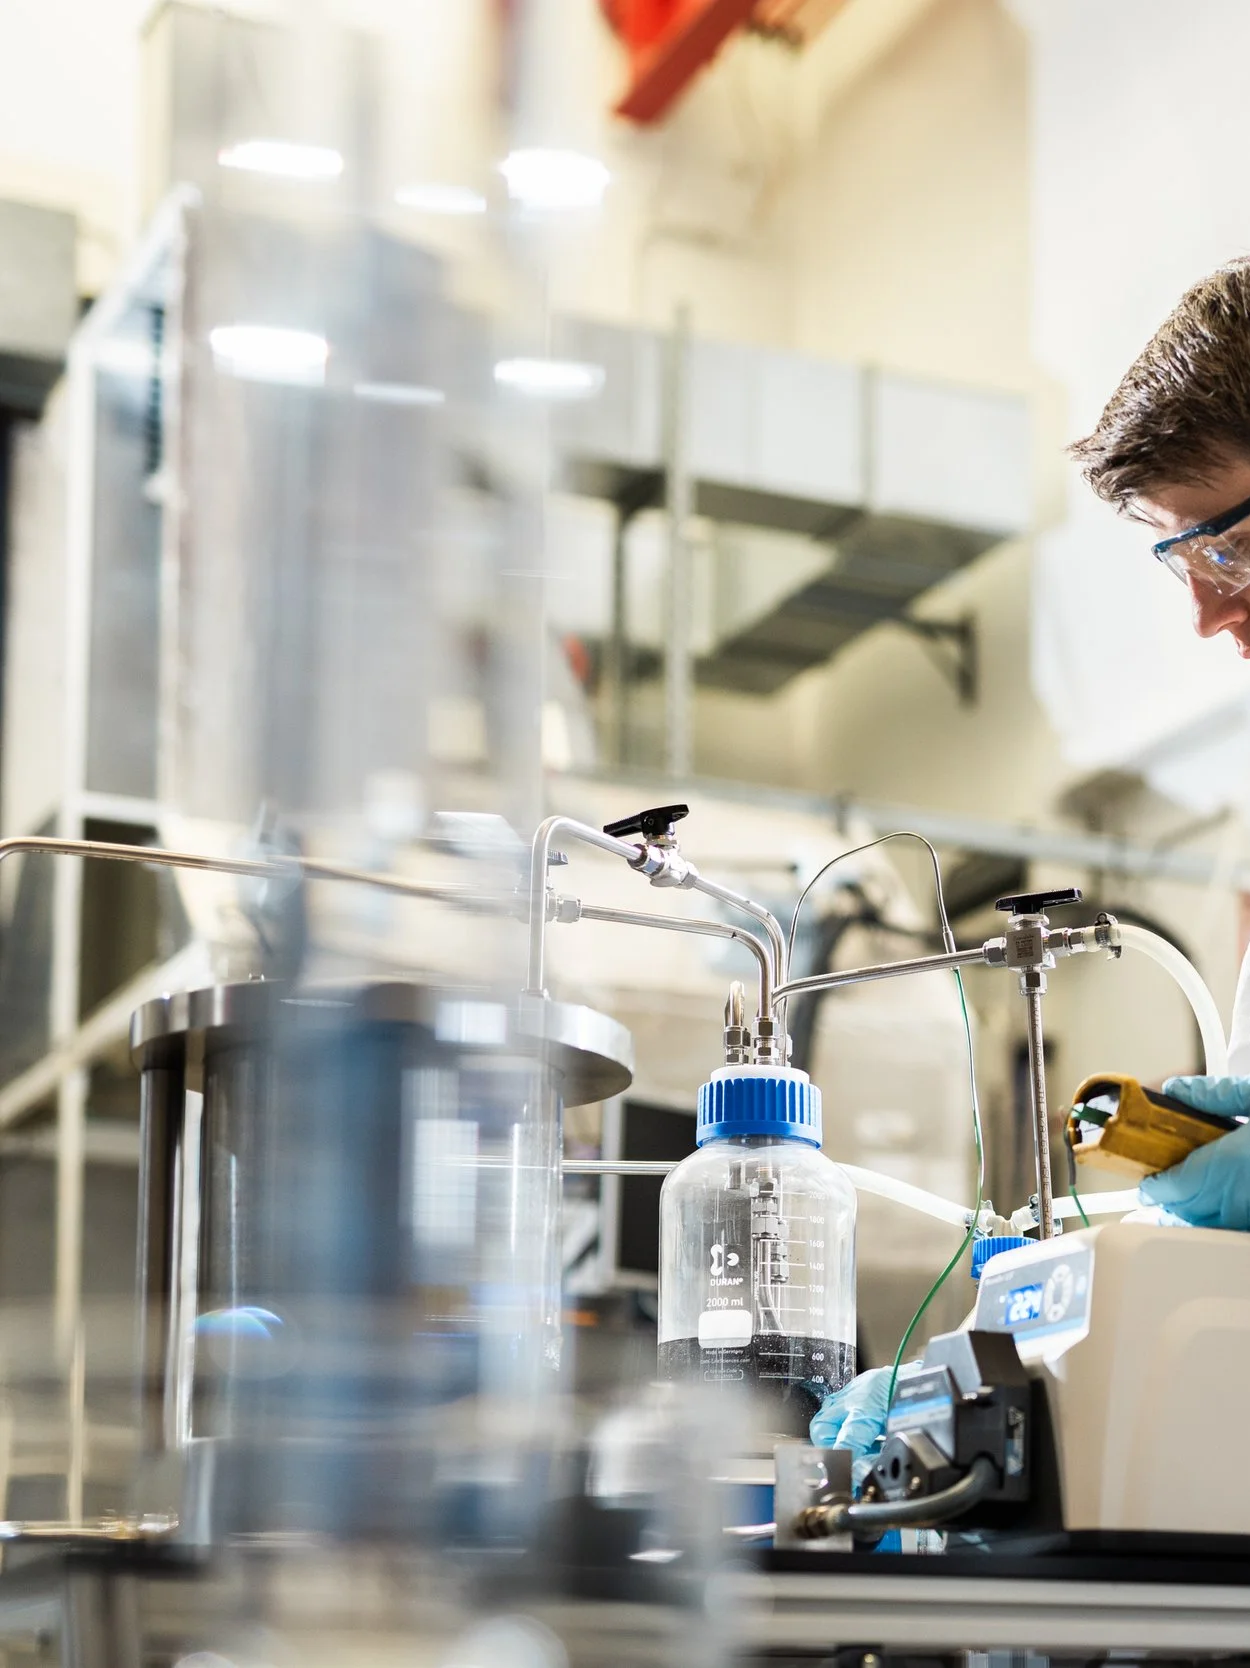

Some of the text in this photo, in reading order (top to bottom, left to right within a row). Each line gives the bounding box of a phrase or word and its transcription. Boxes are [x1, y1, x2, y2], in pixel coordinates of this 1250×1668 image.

[809, 1240, 824, 1248] 1600
[809, 1262, 824, 1270] 1400
[809, 1285, 824, 1293] 1200
[706, 1297, 743, 1307] 2000 ml
[812, 1353, 824, 1361] 600
[812, 1375, 824, 1383] 400
